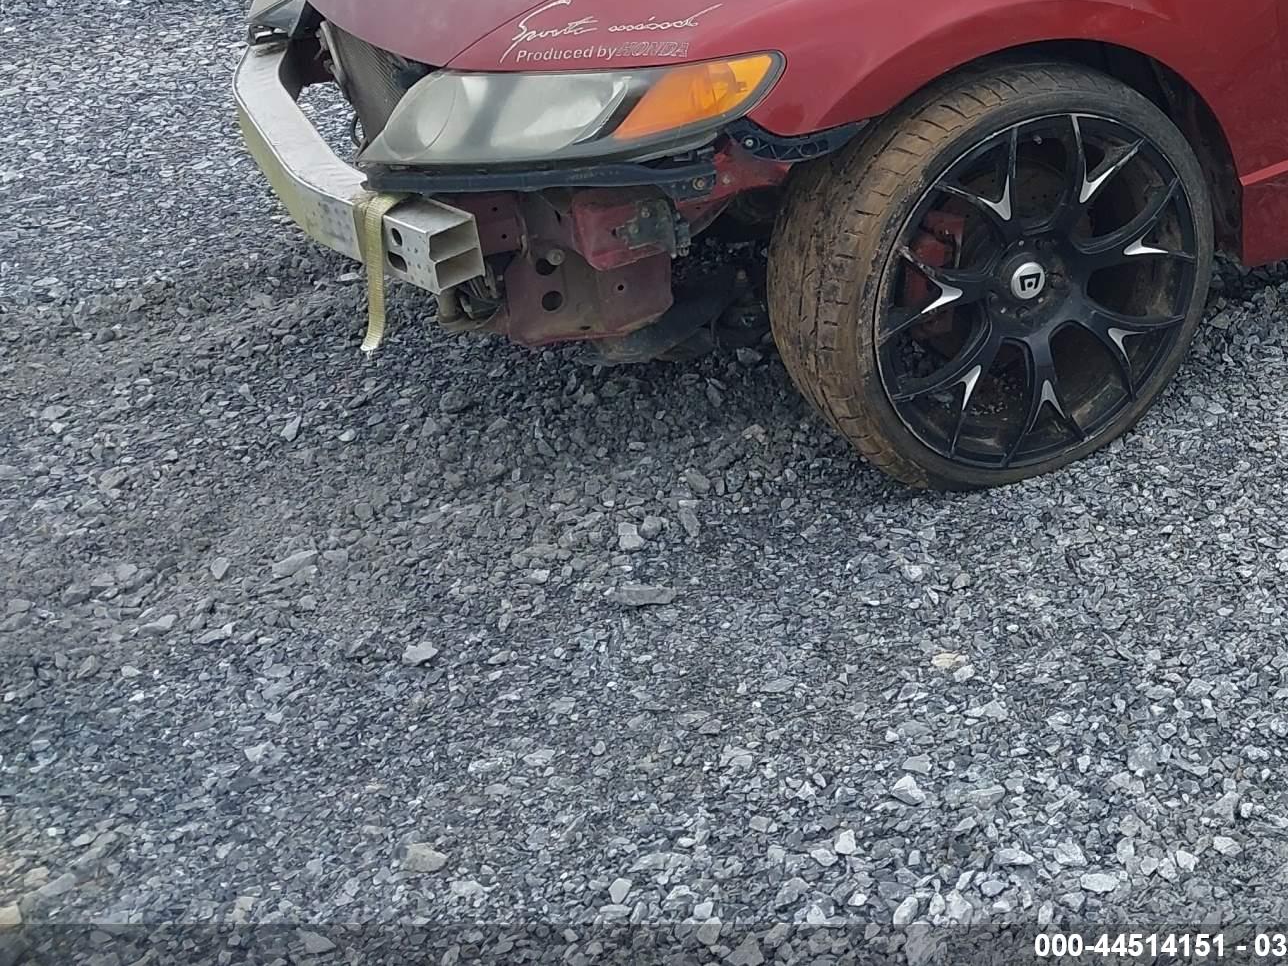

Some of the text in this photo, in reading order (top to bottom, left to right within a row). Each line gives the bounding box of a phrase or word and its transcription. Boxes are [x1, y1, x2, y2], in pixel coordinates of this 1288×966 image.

[516, 41, 689, 63] Produced by HONDA
